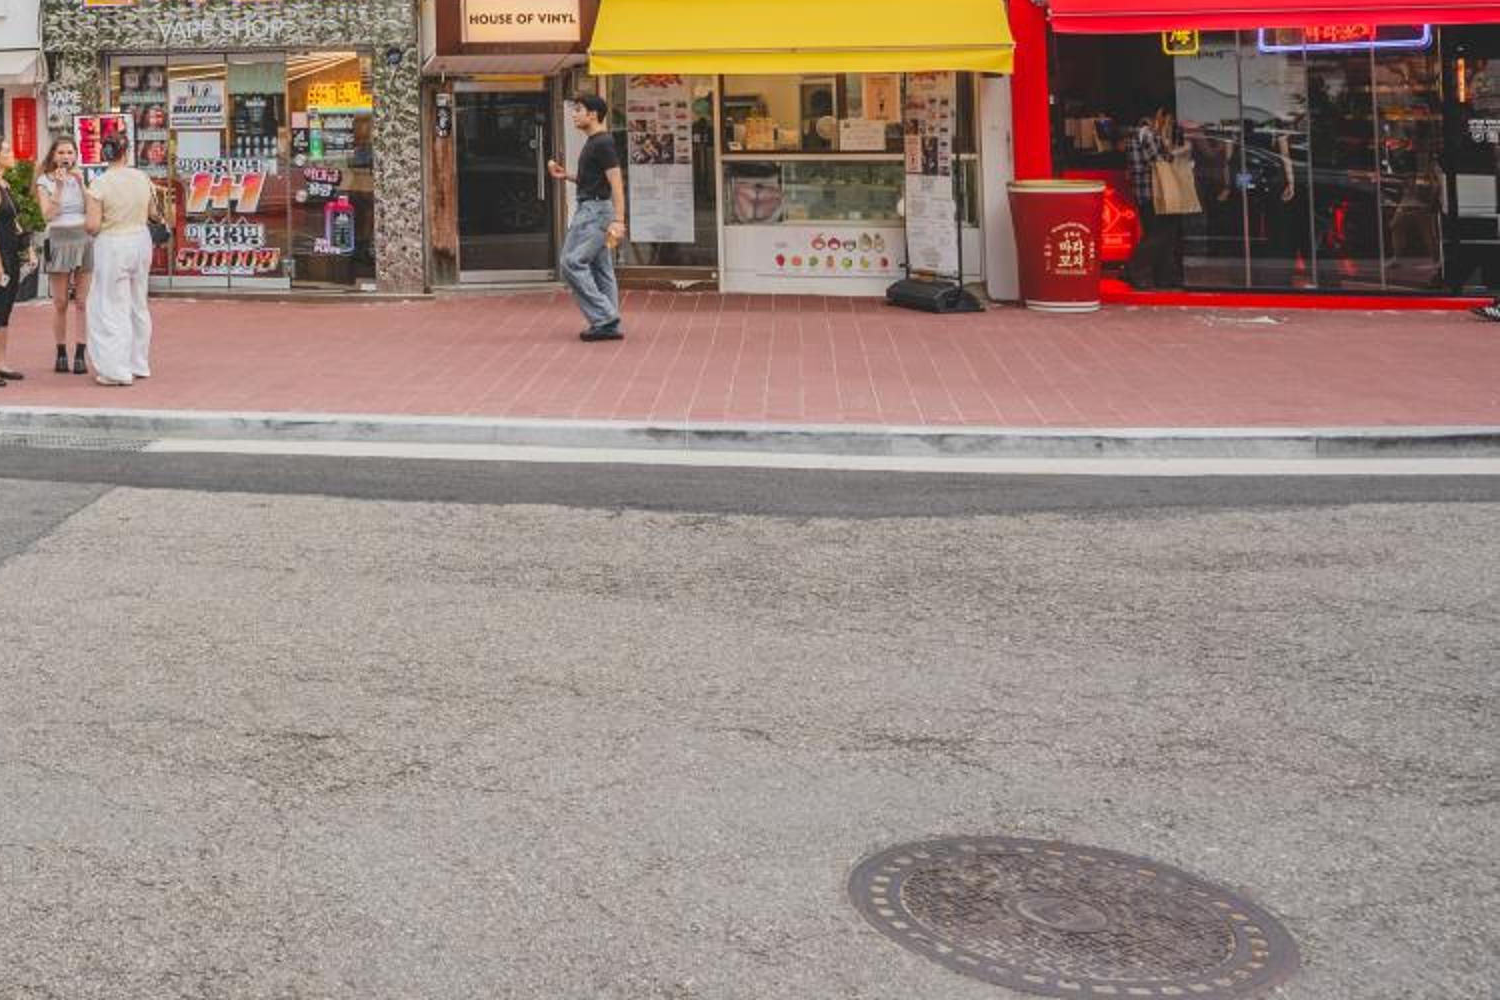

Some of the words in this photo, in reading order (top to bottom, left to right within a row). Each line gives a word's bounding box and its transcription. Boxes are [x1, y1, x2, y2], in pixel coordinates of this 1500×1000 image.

[220, 17, 285, 37] SHOP
[469, 13, 512, 25] HOUSE
[516, 13, 534, 25] OF
[538, 12, 576, 24] VINYL
[187, 172, 267, 214] 1+1
